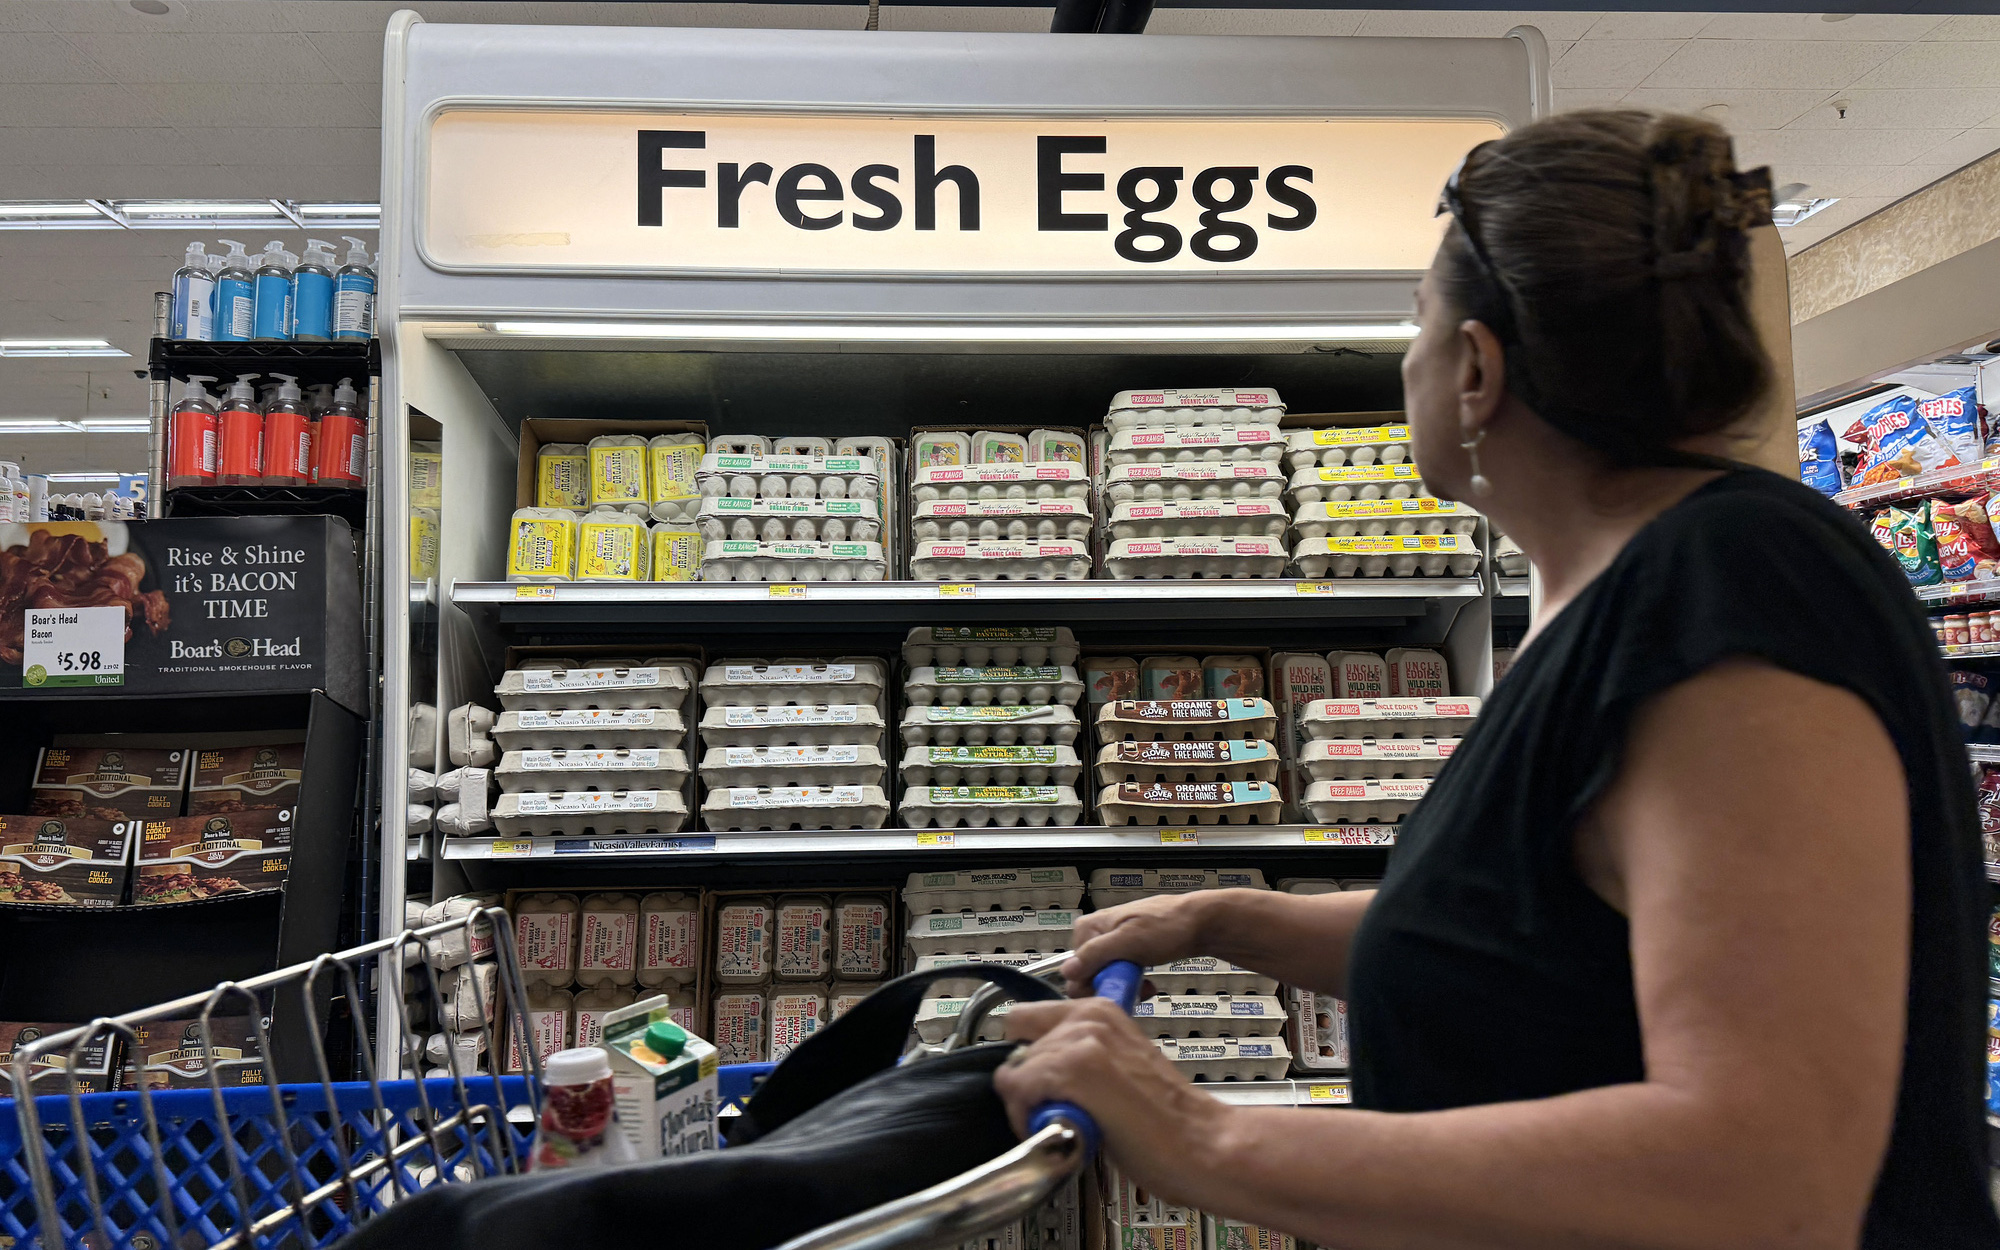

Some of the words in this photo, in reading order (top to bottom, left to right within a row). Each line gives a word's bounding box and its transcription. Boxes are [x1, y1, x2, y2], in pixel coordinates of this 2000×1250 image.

[636, 129, 982, 233] Fresh
[1037, 134, 1316, 263] Eggs
[1919, 398, 1964, 417] FFLES
[612, 452, 622, 484] ORGANIC
[672, 451, 684, 482] ORGANIC
[561, 461, 570, 492] ORGANIC
[130, 480, 146, 500] 5
[732, 500, 750, 508] RANGE
[603, 529, 614, 560] ORGANIC
[1143, 544, 1161, 552] RANGE
[167, 547, 212, 566] Rise
[221, 547, 239, 565] &
[245, 544, 305, 565] Shine
[535, 536, 546, 570] ORGANIC
[947, 547, 965, 555] RANGE
[175, 573, 202, 593] it's
[210, 571, 297, 592] BACON
[204, 599, 268, 618] TIME
[32, 614, 56, 624] Boar's
[59, 614, 78, 624] Head
[32, 629, 52, 638] Bacon
[170, 639, 222, 658] Boar's
[252, 637, 300, 657] Head
[58, 651, 100, 671] $5.98
[1406, 662, 1440, 671] UNCLE
[1289, 667, 1323, 676] UNCLE
[95, 675, 119, 684] United
[1407, 680, 1425, 688] WILD
[1427, 680, 1441, 688] HEN
[1291, 685, 1308, 693] WILD
[1311, 685, 1325, 693] HEN
[1408, 689, 1442, 697] FARM
[1191, 709, 1213, 717] RANGE
[1327, 705, 1340, 714] FREE
[1341, 705, 1359, 714] RANGE
[1329, 746, 1342, 754] FREE
[1343, 745, 1362, 754] RANGE
[1175, 751, 1192, 759] FREE
[1193, 750, 1215, 759] RANGE
[86, 774, 132, 782] TRADITIONAL
[242, 771, 286, 780] TRADITIONAL
[1175, 784, 1217, 792] ORGANIC
[1331, 787, 1344, 795] FREE
[1346, 787, 1364, 795] RANGE
[1177, 792, 1194, 800] FREE
[1195, 792, 1218, 800] RANGE
[1340, 827, 1370, 836] NCLE
[24, 846, 72, 854] TRADITIONAL
[192, 841, 241, 852] TRADITIONAL
[262, 864, 288, 872] COOKED
[1303, 1000, 1311, 1022] JUMBO
